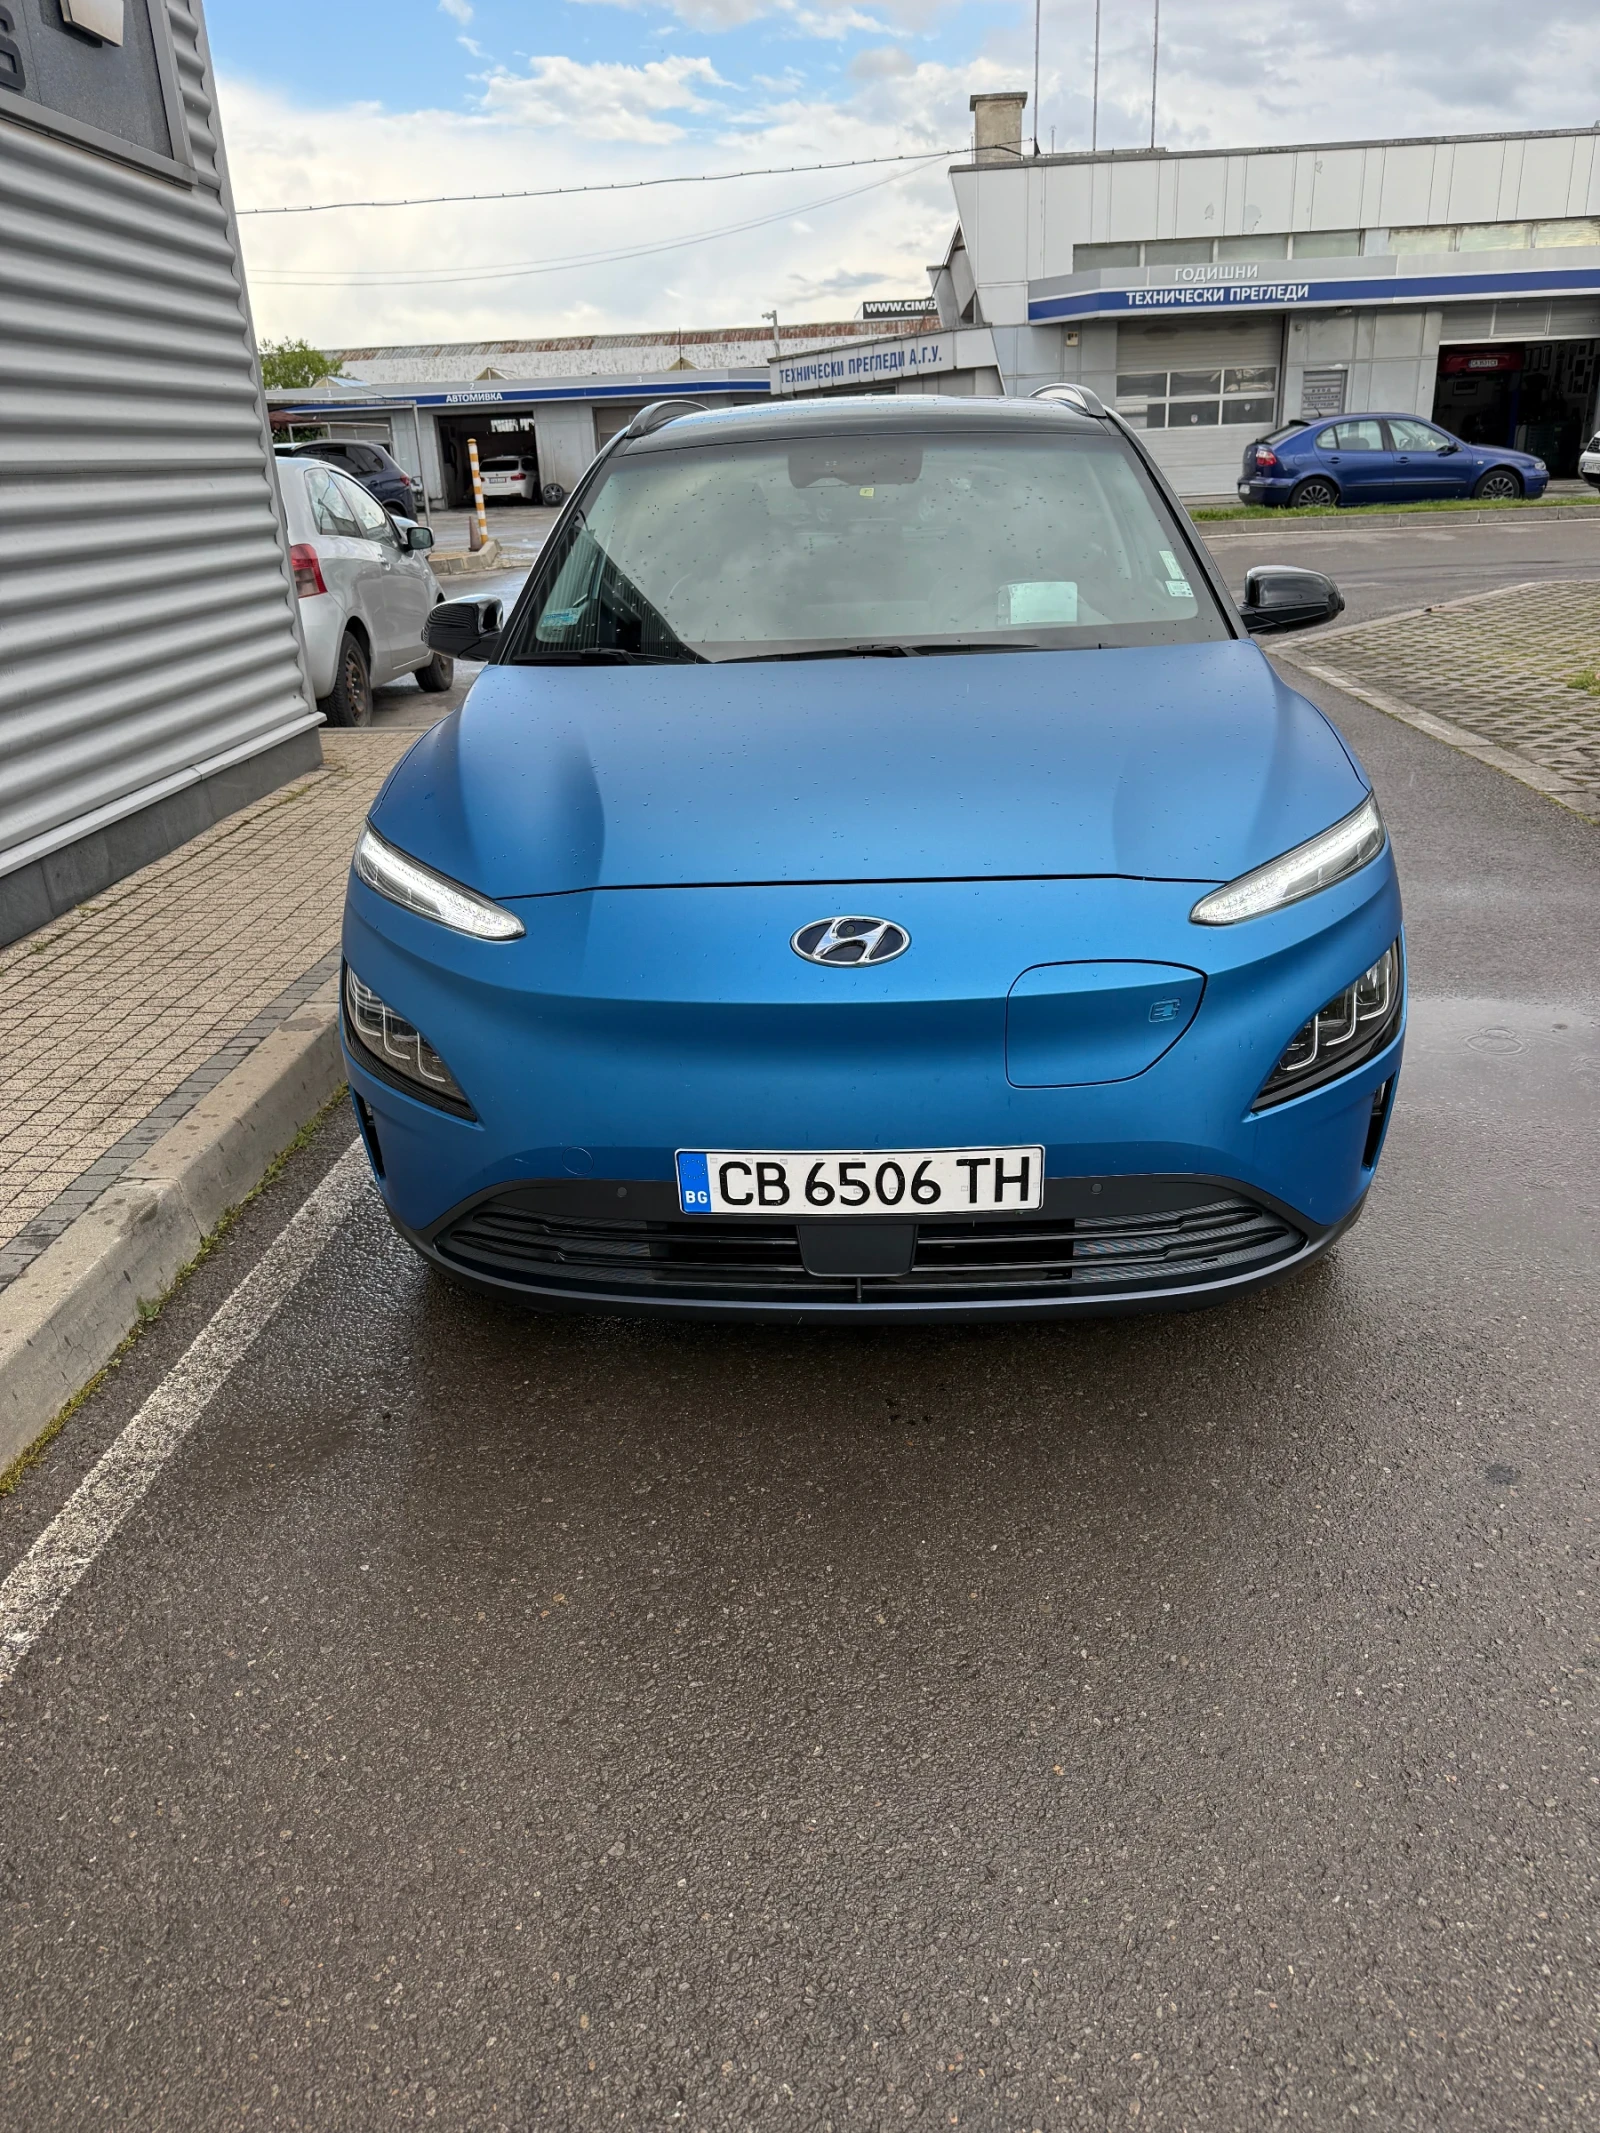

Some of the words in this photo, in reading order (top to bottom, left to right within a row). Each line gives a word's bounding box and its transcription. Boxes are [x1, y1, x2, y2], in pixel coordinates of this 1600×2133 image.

[1174, 264, 1259, 283] ГОДИШНИ
[1126, 288, 1224, 306] ТЕХНИЧЕСКИ
[1229, 284, 1310, 301] ПРЕГЛЕДИ
[779, 360, 844, 384] ТЕХНИЧЕСКИ
[848, 351, 905, 374] ПРЕГЛЕДИ
[909, 345, 942, 365] А.Г.У.
[469, 382, 475, 391] 2
[445, 392, 503, 404] АВТОМИВКА
[685, 1190, 708, 1204] BG
[718, 1160, 791, 1207] CB
[804, 1159, 942, 1207] 6506
[956, 1156, 1031, 1204] TH
